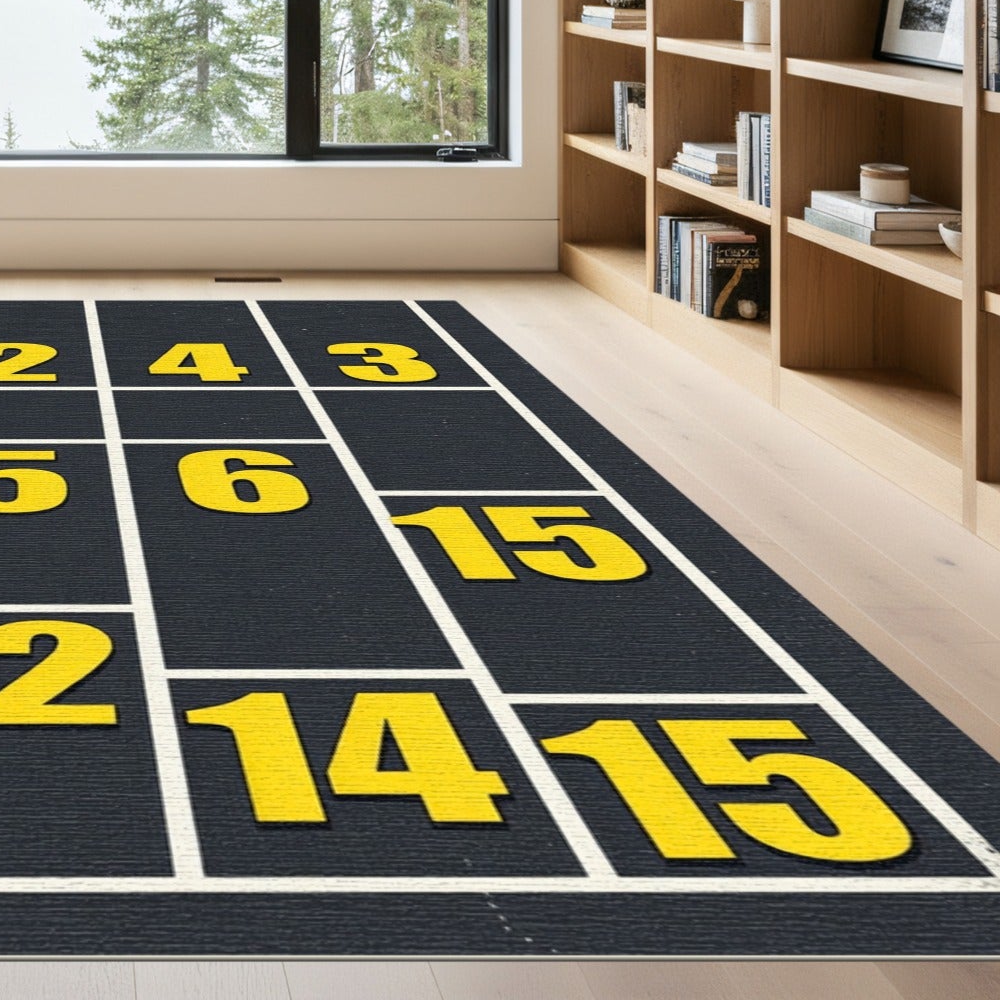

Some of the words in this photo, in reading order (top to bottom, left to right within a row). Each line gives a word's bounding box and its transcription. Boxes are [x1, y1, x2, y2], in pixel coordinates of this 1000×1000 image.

[148, 342, 249, 382] 4
[327, 342, 438, 383] 3
[178, 449, 310, 515] 6
[392, 505, 650, 582] 15
[186, 691, 510, 824] 14
[541, 718, 913, 863] 15
